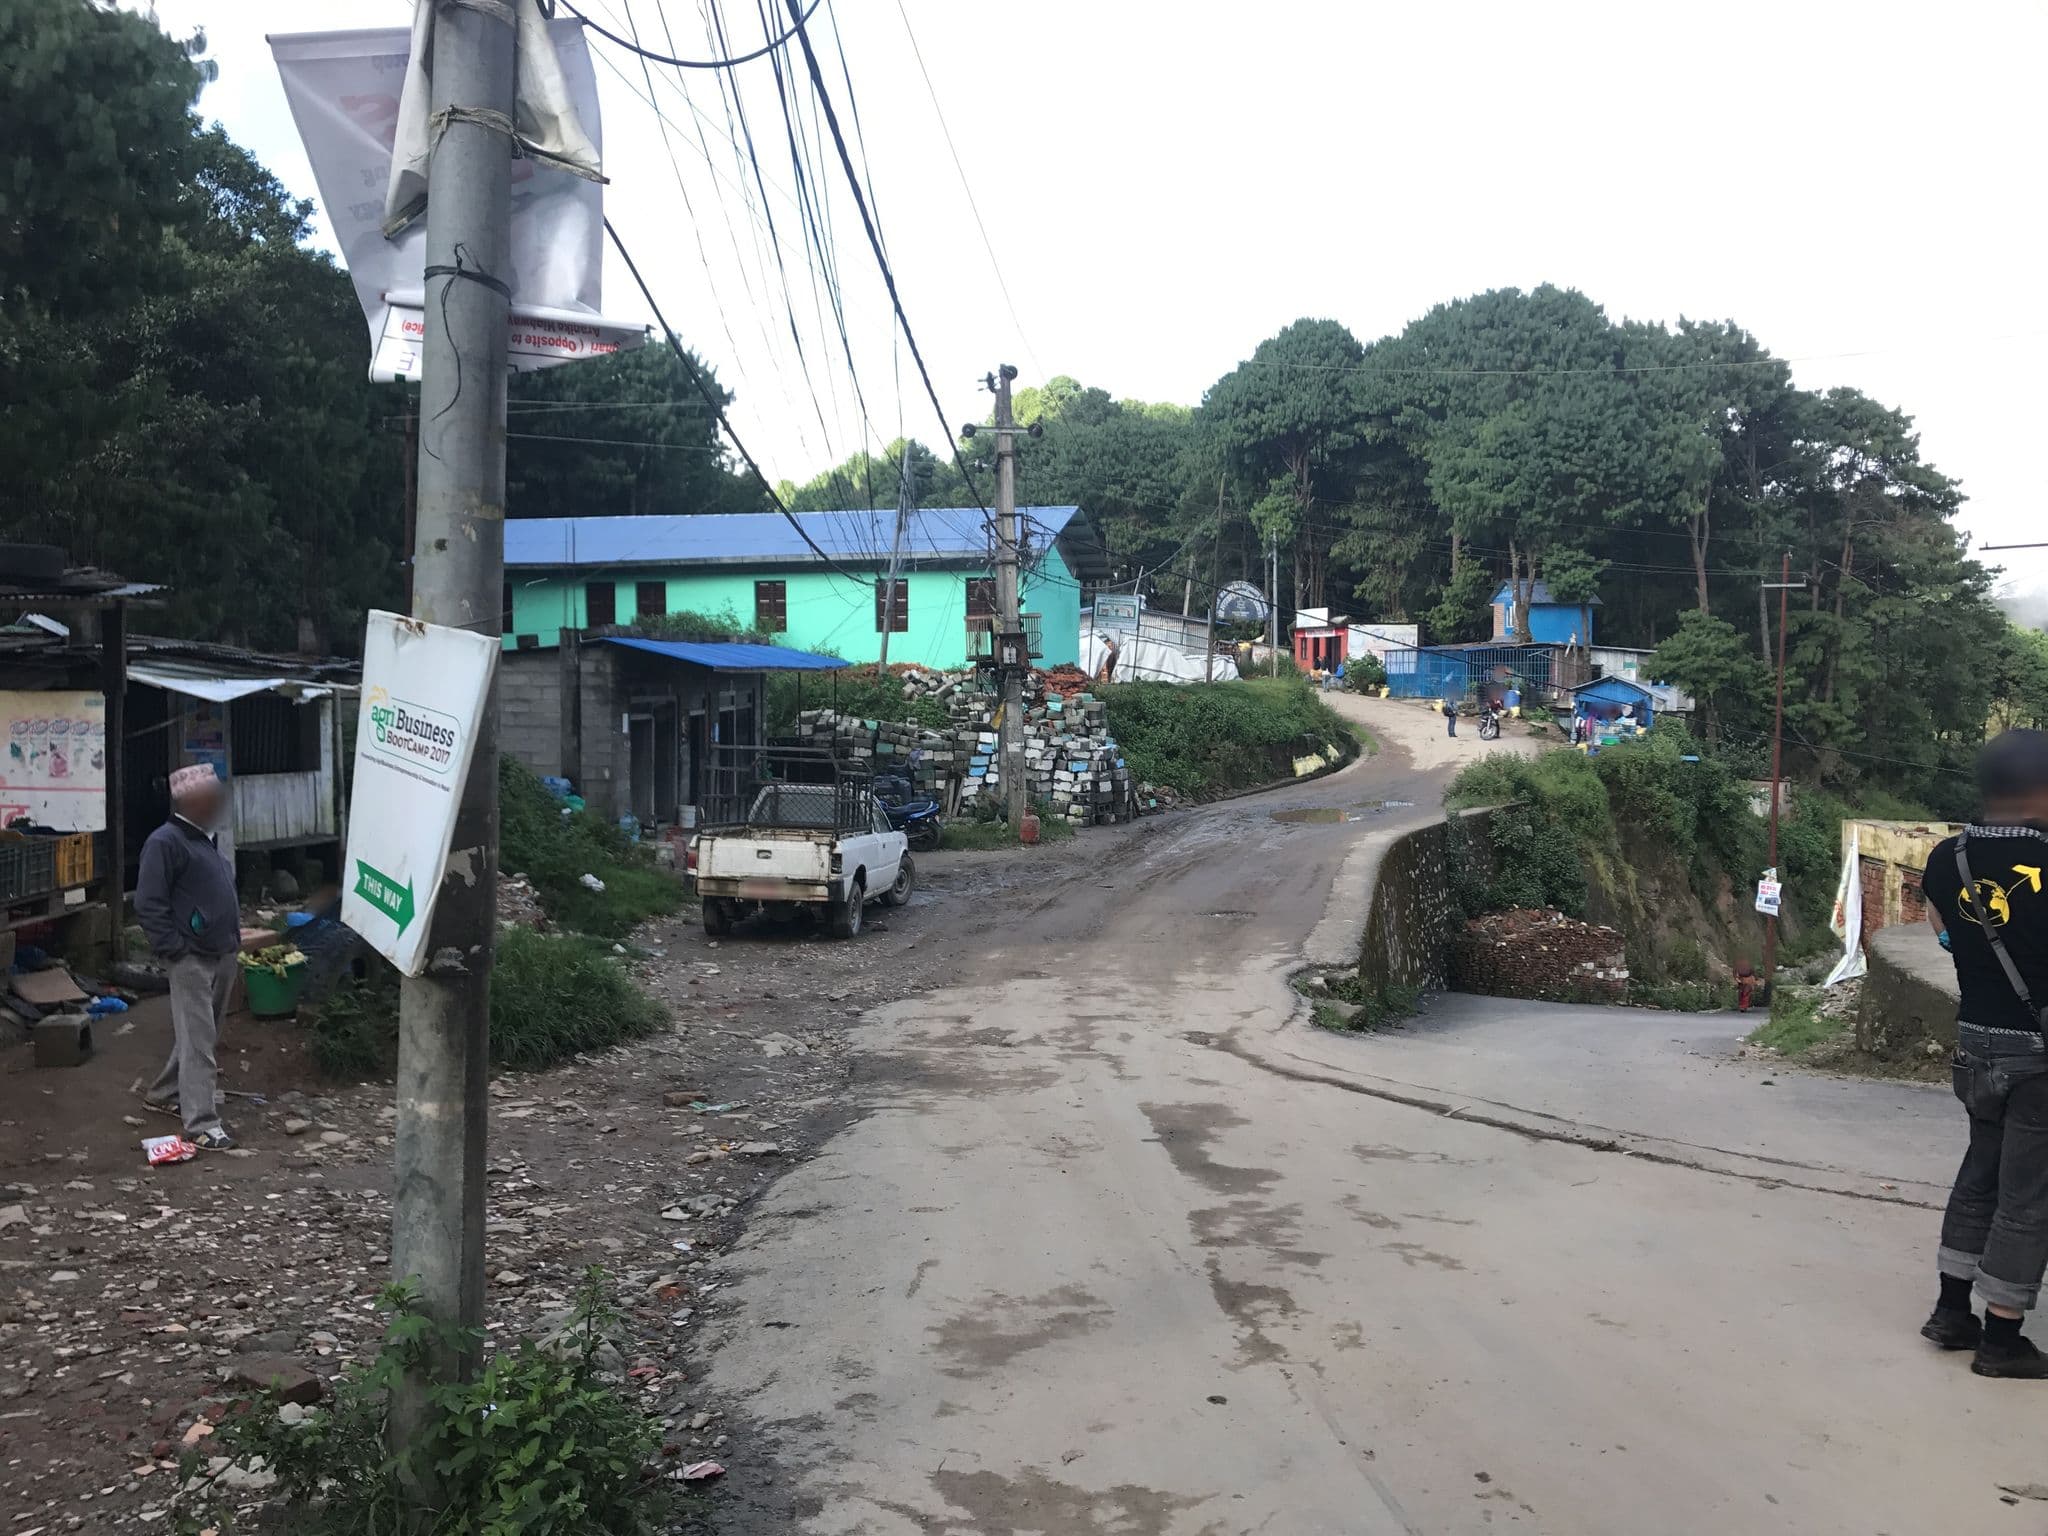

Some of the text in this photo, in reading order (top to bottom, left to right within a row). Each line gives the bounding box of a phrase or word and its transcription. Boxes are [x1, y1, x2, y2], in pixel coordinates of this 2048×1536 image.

[511, 333, 523, 346] to
[524, 333, 577, 353] Opposite
[430, 746, 451, 765] 2017
[363, 872, 403, 912] THIS WAY
